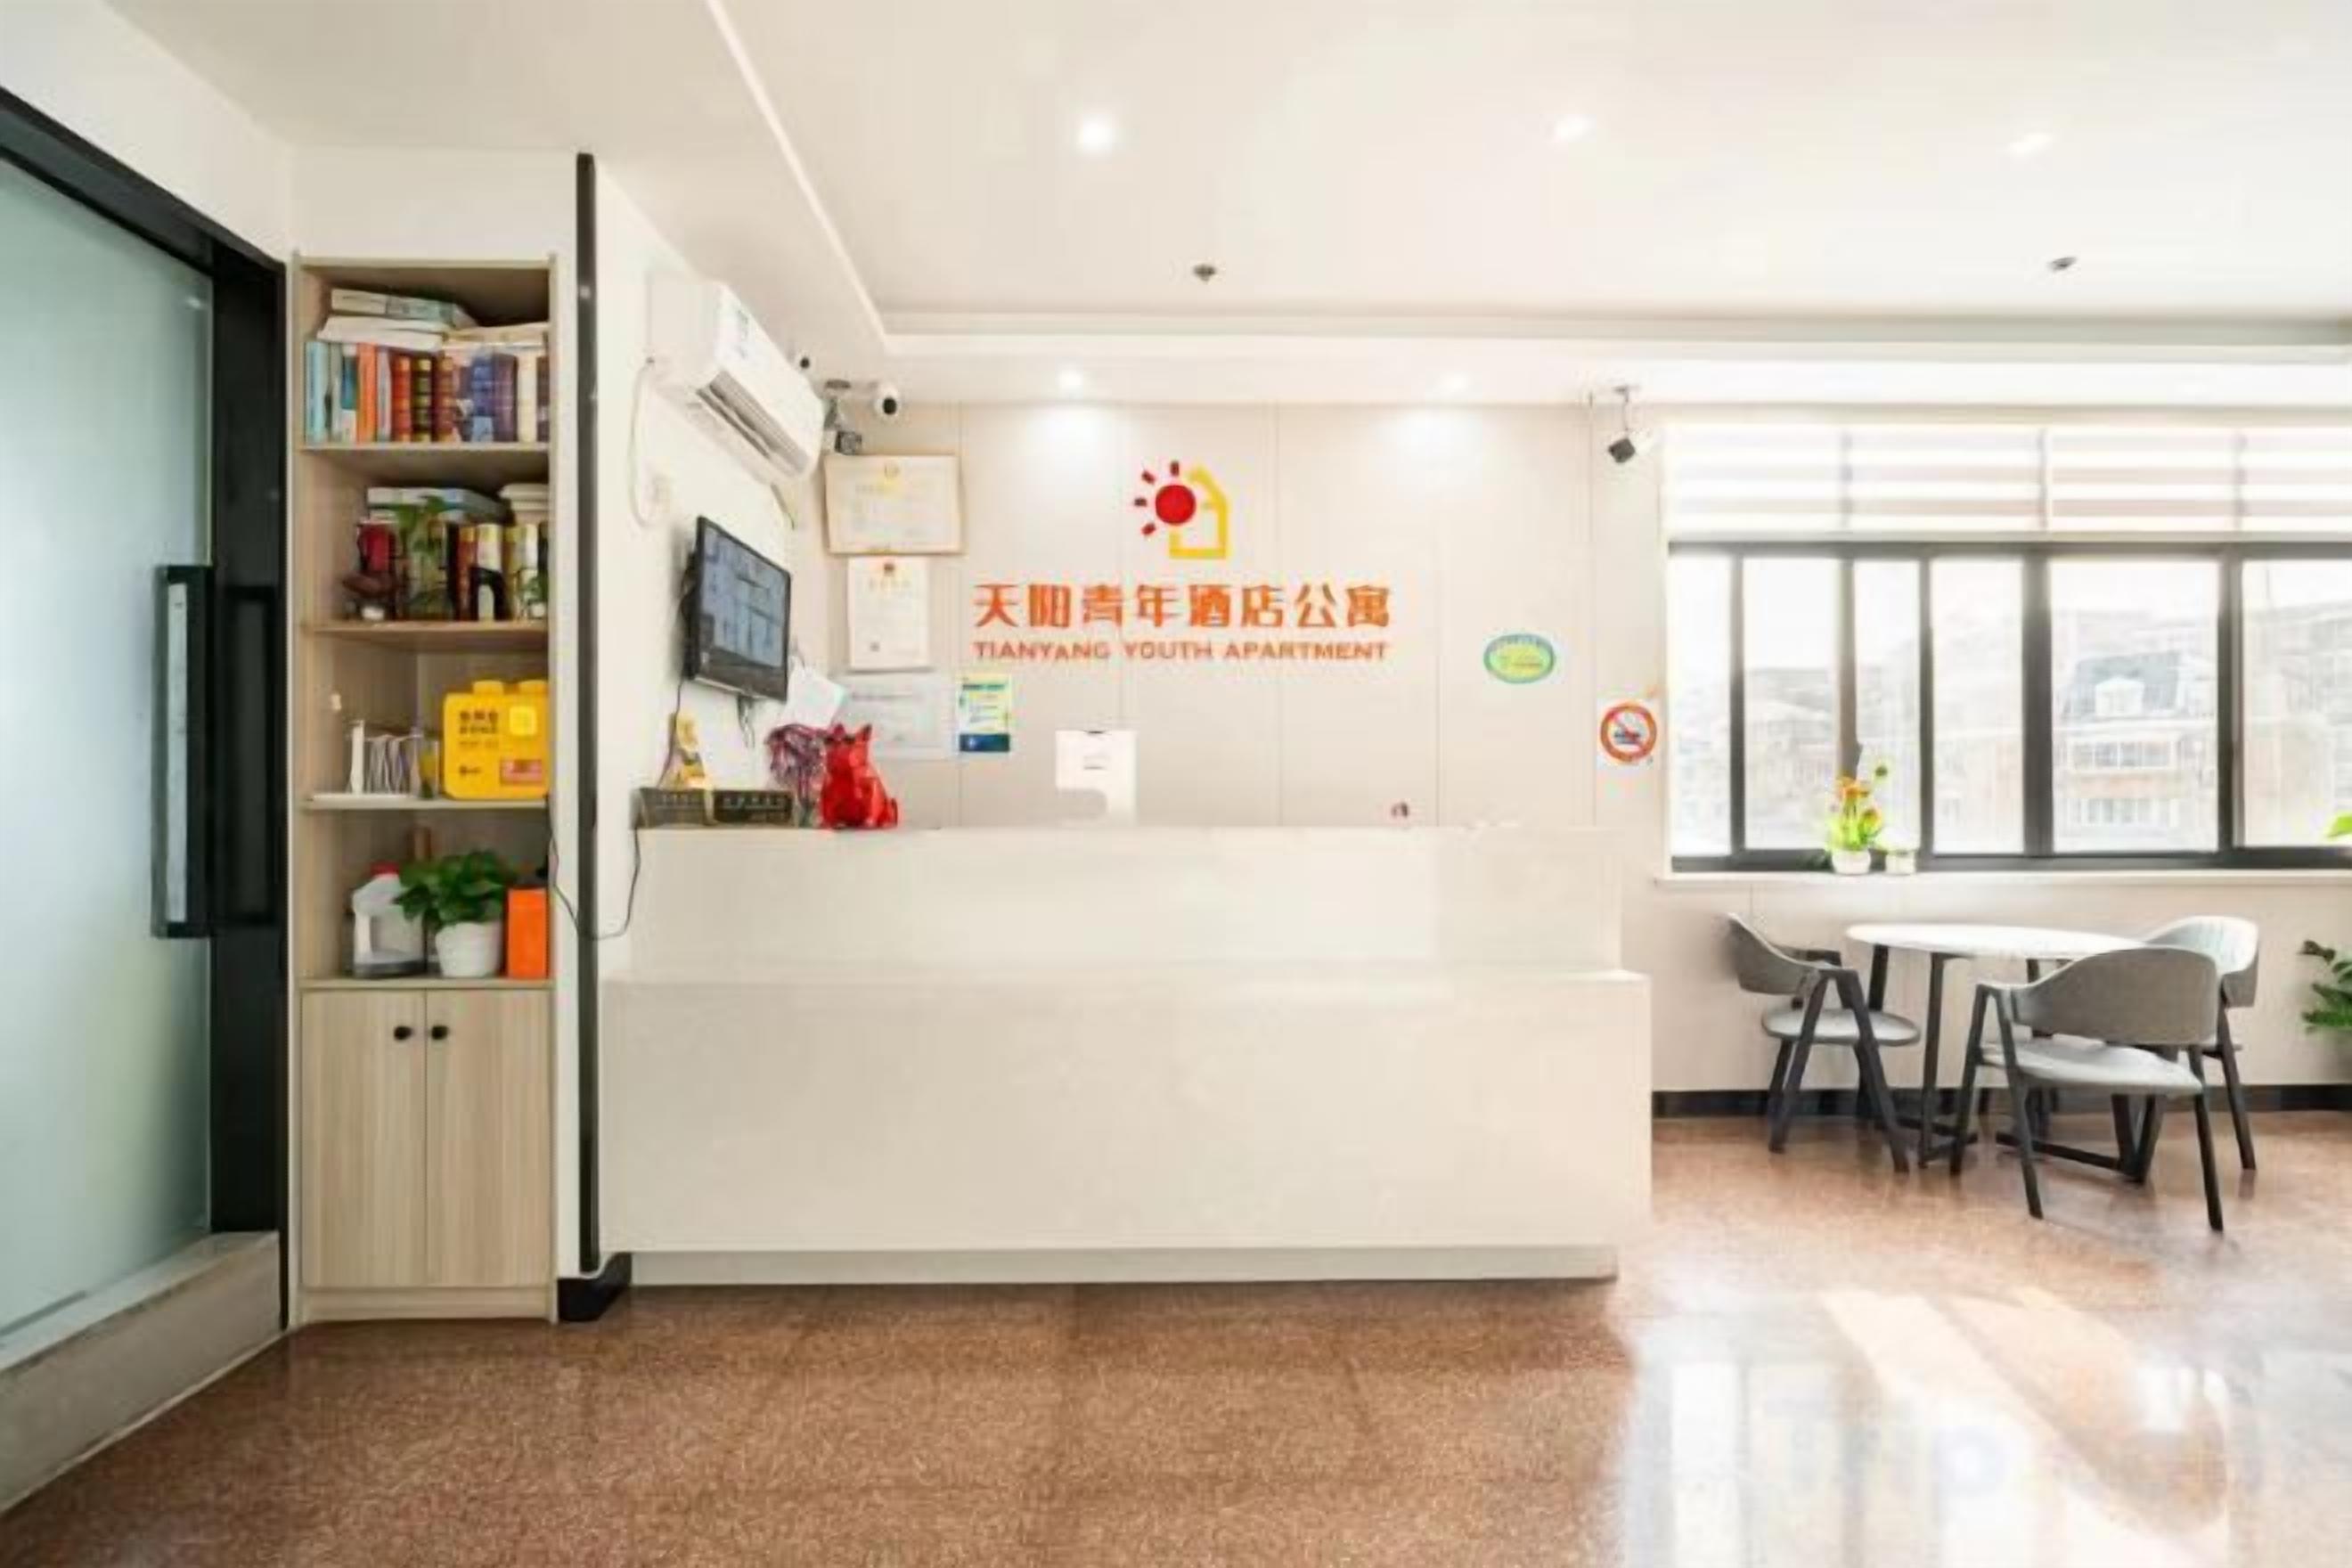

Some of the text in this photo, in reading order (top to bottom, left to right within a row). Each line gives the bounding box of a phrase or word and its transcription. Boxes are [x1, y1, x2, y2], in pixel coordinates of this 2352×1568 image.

[973, 584, 1391, 627] 天阳青年酒店公寓
[975, 641, 1386, 659] TIANYANG YOUTH APARTMENT
